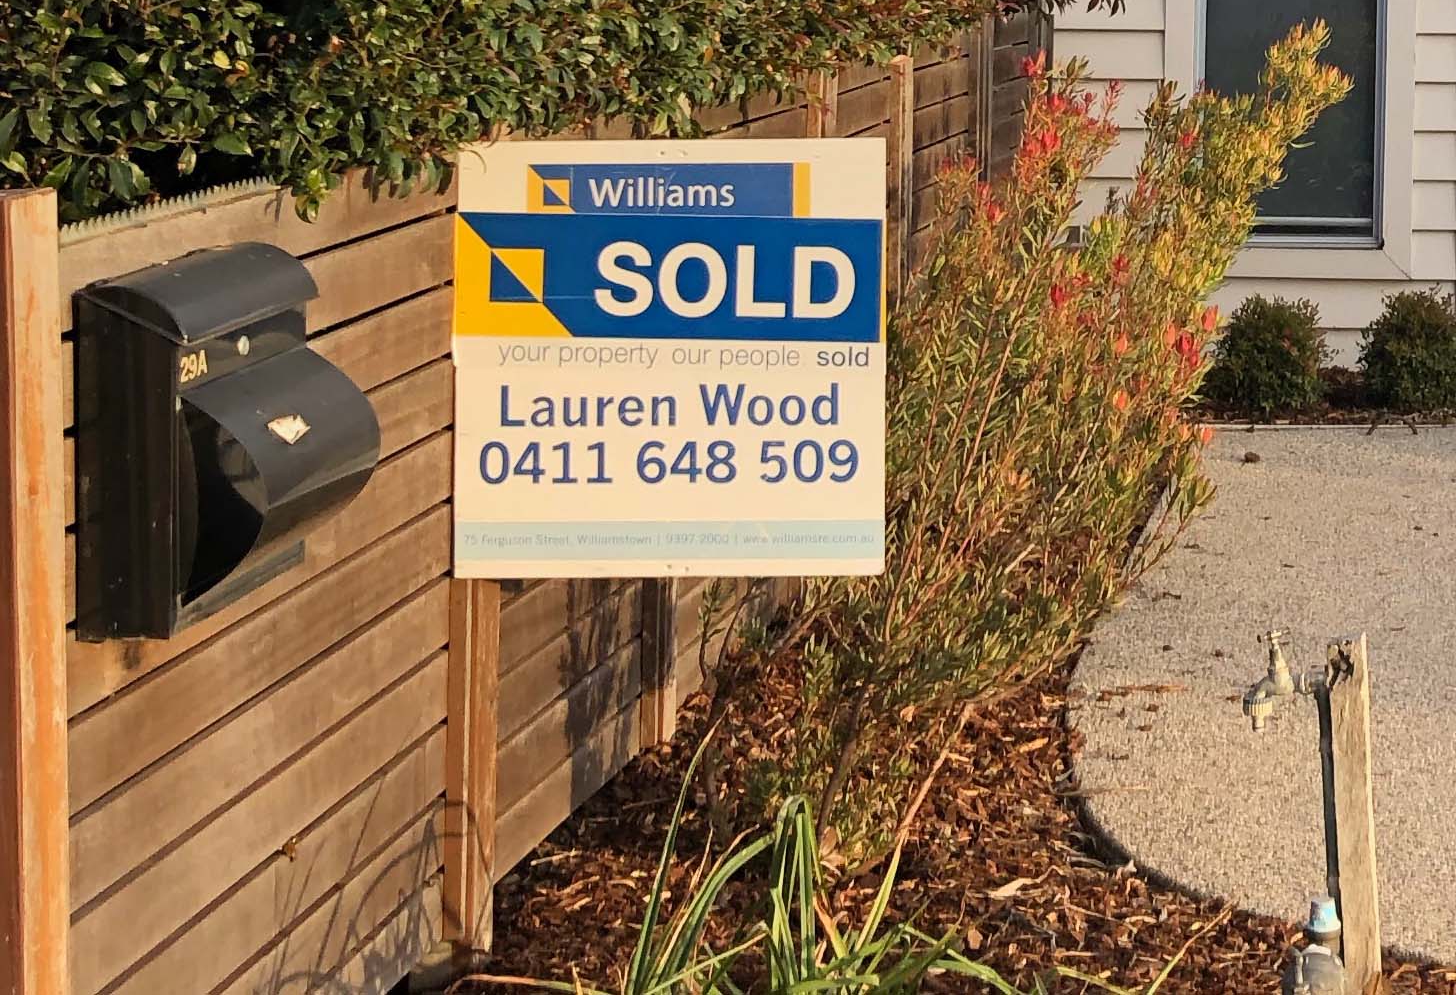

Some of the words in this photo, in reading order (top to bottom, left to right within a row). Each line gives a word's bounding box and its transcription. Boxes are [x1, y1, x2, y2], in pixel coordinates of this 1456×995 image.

[589, 178, 735, 208] Williams
[593, 241, 857, 318] SOLD
[180, 349, 208, 383] 29A
[499, 344, 550, 365] your
[558, 342, 658, 370] property
[671, 346, 710, 365] our
[719, 344, 801, 371] people
[816, 346, 871, 368] sold
[499, 384, 678, 428] Lauren
[699, 382, 840, 426] Wood
[479, 440, 614, 485] 0411
[636, 440, 737, 484] 648
[759, 439, 860, 483] 509
